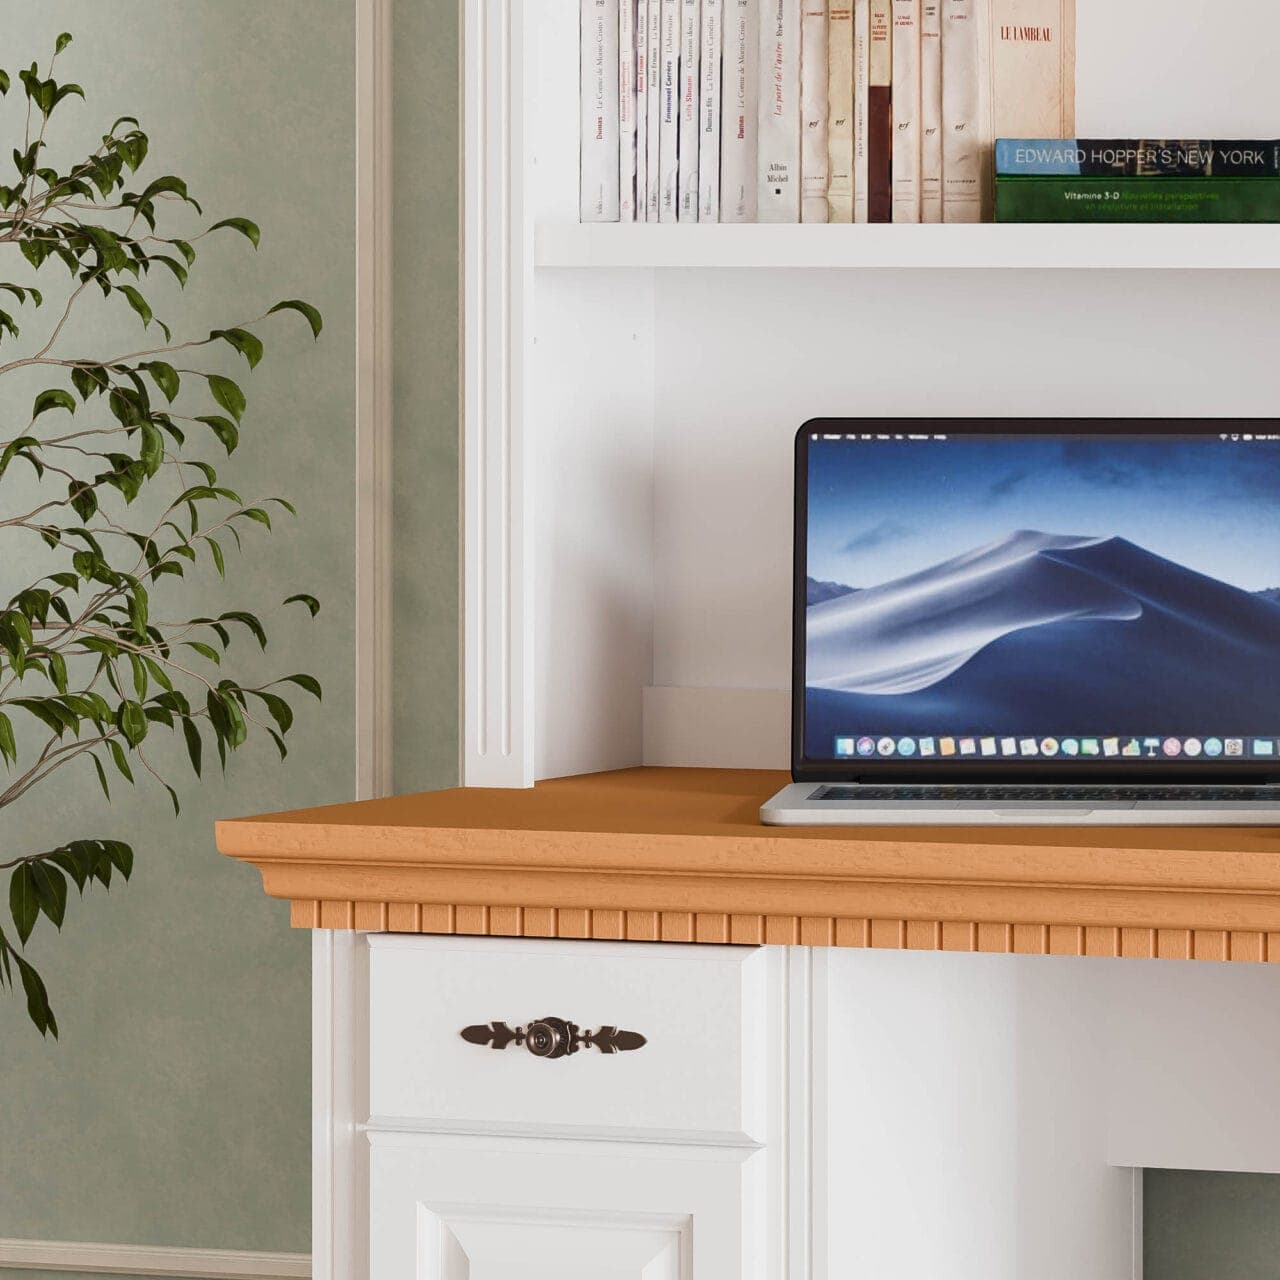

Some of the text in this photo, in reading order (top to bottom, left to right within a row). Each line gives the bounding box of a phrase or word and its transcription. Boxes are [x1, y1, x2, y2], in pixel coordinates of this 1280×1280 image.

[1000, 26, 1052, 42] LE LAMBEAU
[737, 20, 745, 65] Monte-Cristo
[706, 48, 714, 59] aux
[596, 67, 604, 76] de
[706, 60, 714, 81] Dame
[737, 66, 745, 74] de
[774, 42, 783, 116] La part de l'autre
[596, 100, 604, 109] Le
[737, 99, 745, 108] Le
[705, 109, 713, 132] Dumas
[1015, 149, 1086, 164] EDWARD
[1091, 149, 1172, 164] HOPPER'S
[1176, 150, 1214, 165] NEW
[1219, 150, 1265, 165] YORK
[767, 175, 788, 183] Michel
[1064, 191, 1102, 200] Vitamine
[1103, 191, 1120, 200] 3-D
